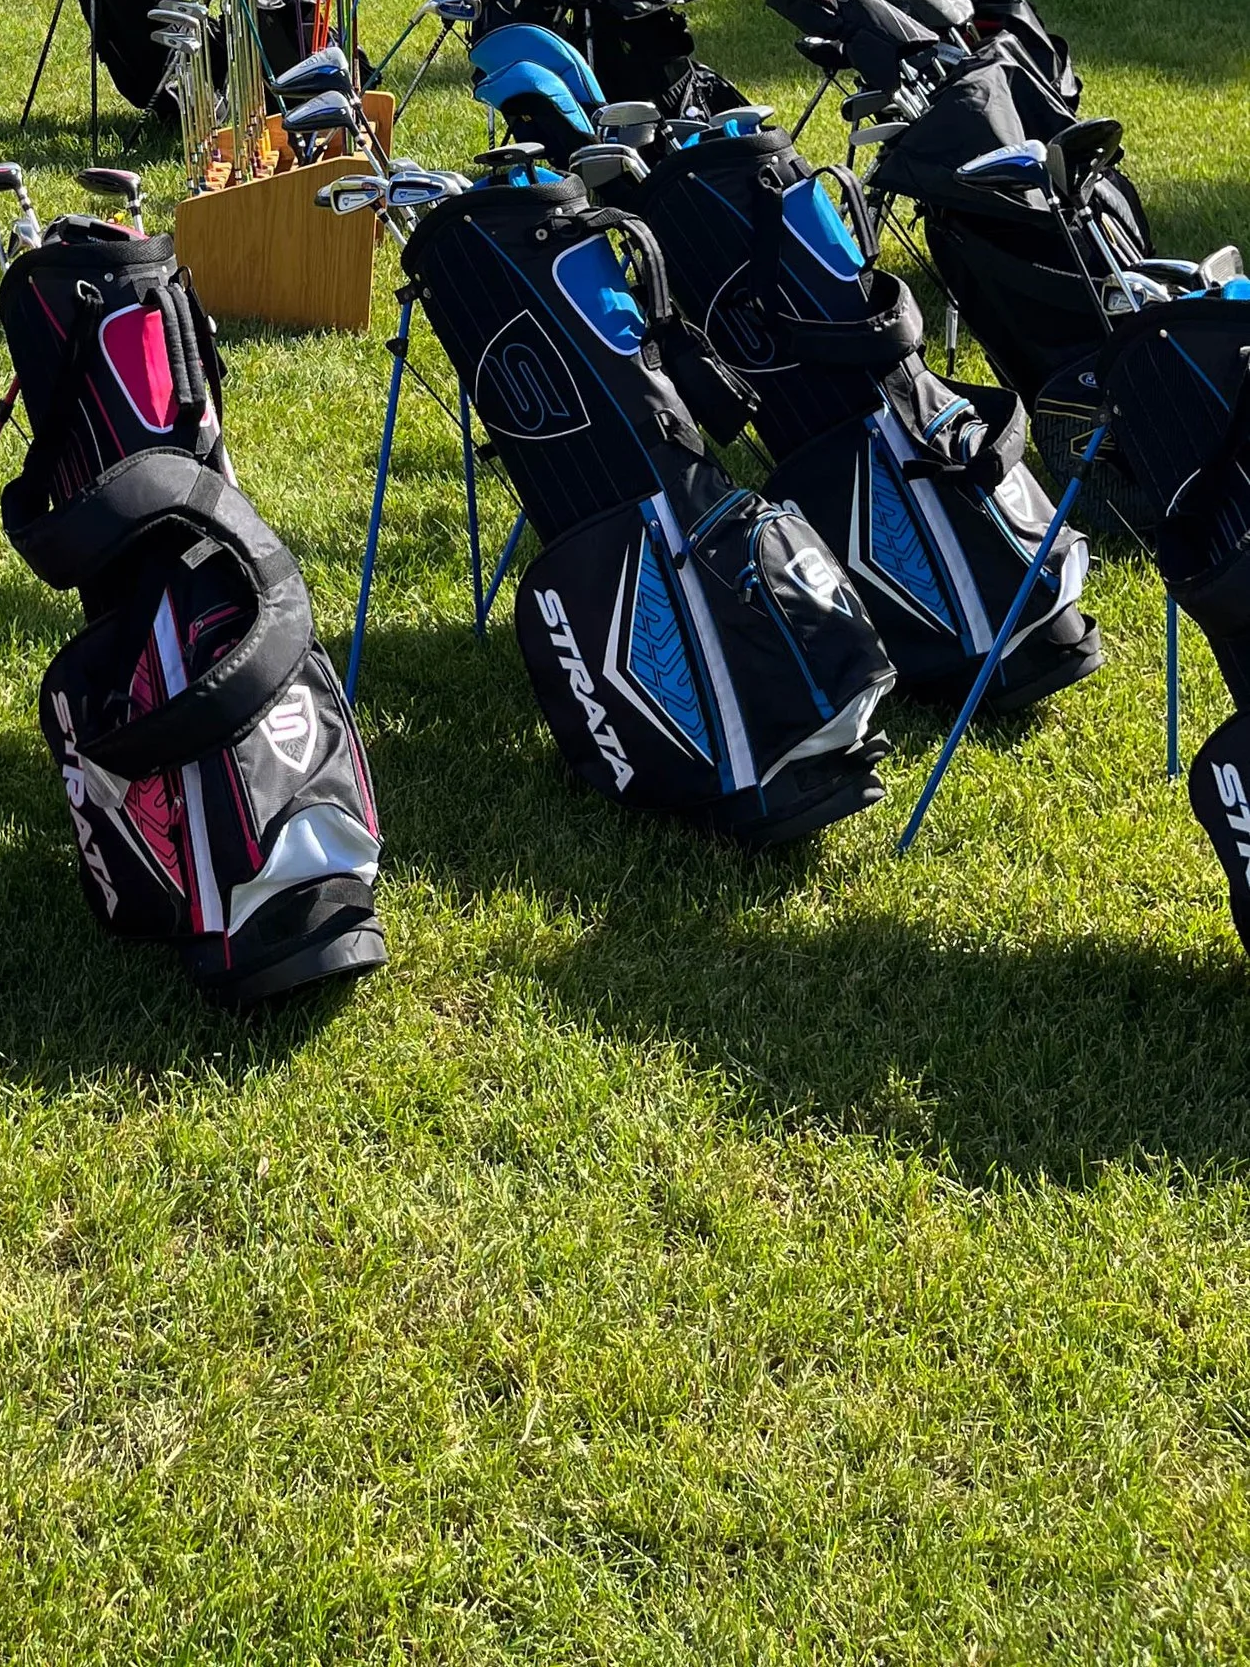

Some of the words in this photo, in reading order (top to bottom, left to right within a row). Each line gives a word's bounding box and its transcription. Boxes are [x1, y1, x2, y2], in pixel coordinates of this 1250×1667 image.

[268, 701, 310, 742] S
[533, 588, 635, 793] STRATA
[50, 690, 119, 920] STRATA
[1210, 761, 1250, 891] ST
